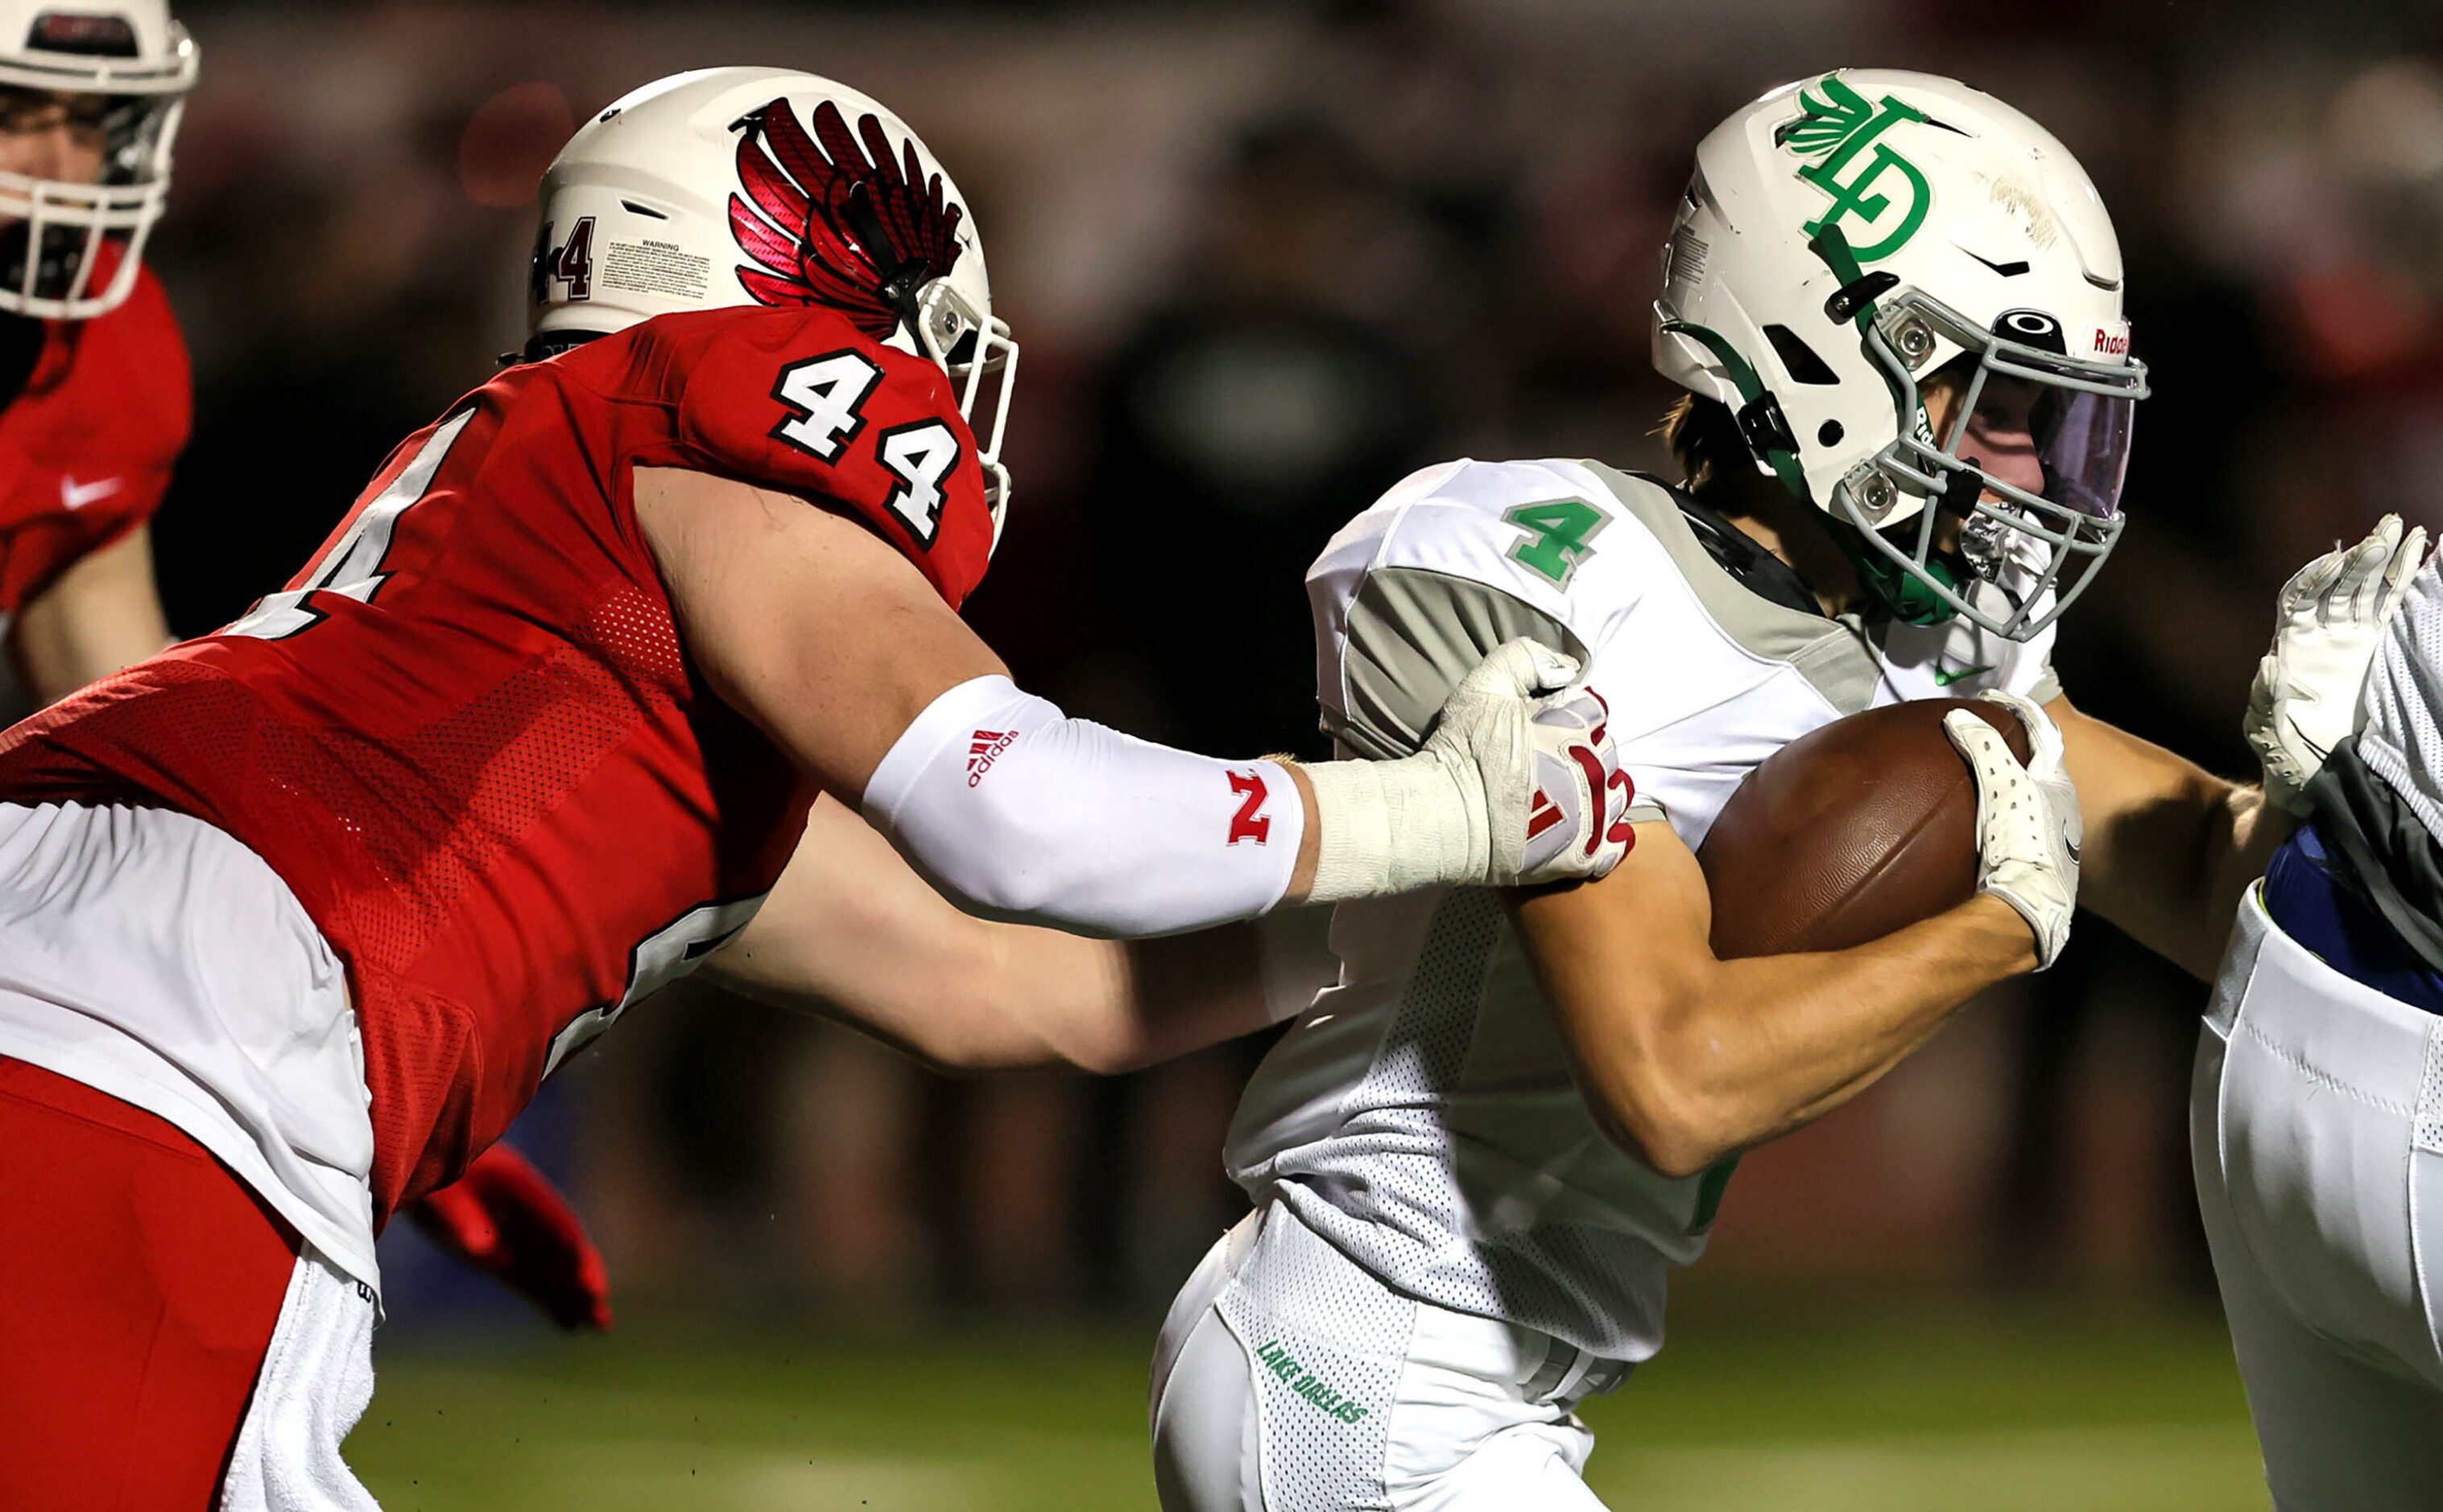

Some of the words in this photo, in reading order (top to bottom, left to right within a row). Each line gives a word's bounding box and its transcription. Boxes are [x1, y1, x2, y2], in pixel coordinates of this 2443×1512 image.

[643, 239, 680, 252] WARNING
[767, 347, 961, 552] 44
[1500, 496, 1615, 595] 4
[968, 729, 1019, 788] adidas
[1256, 1339, 1303, 1384] LAKE
[1292, 1374, 1369, 1424] DALLAS
